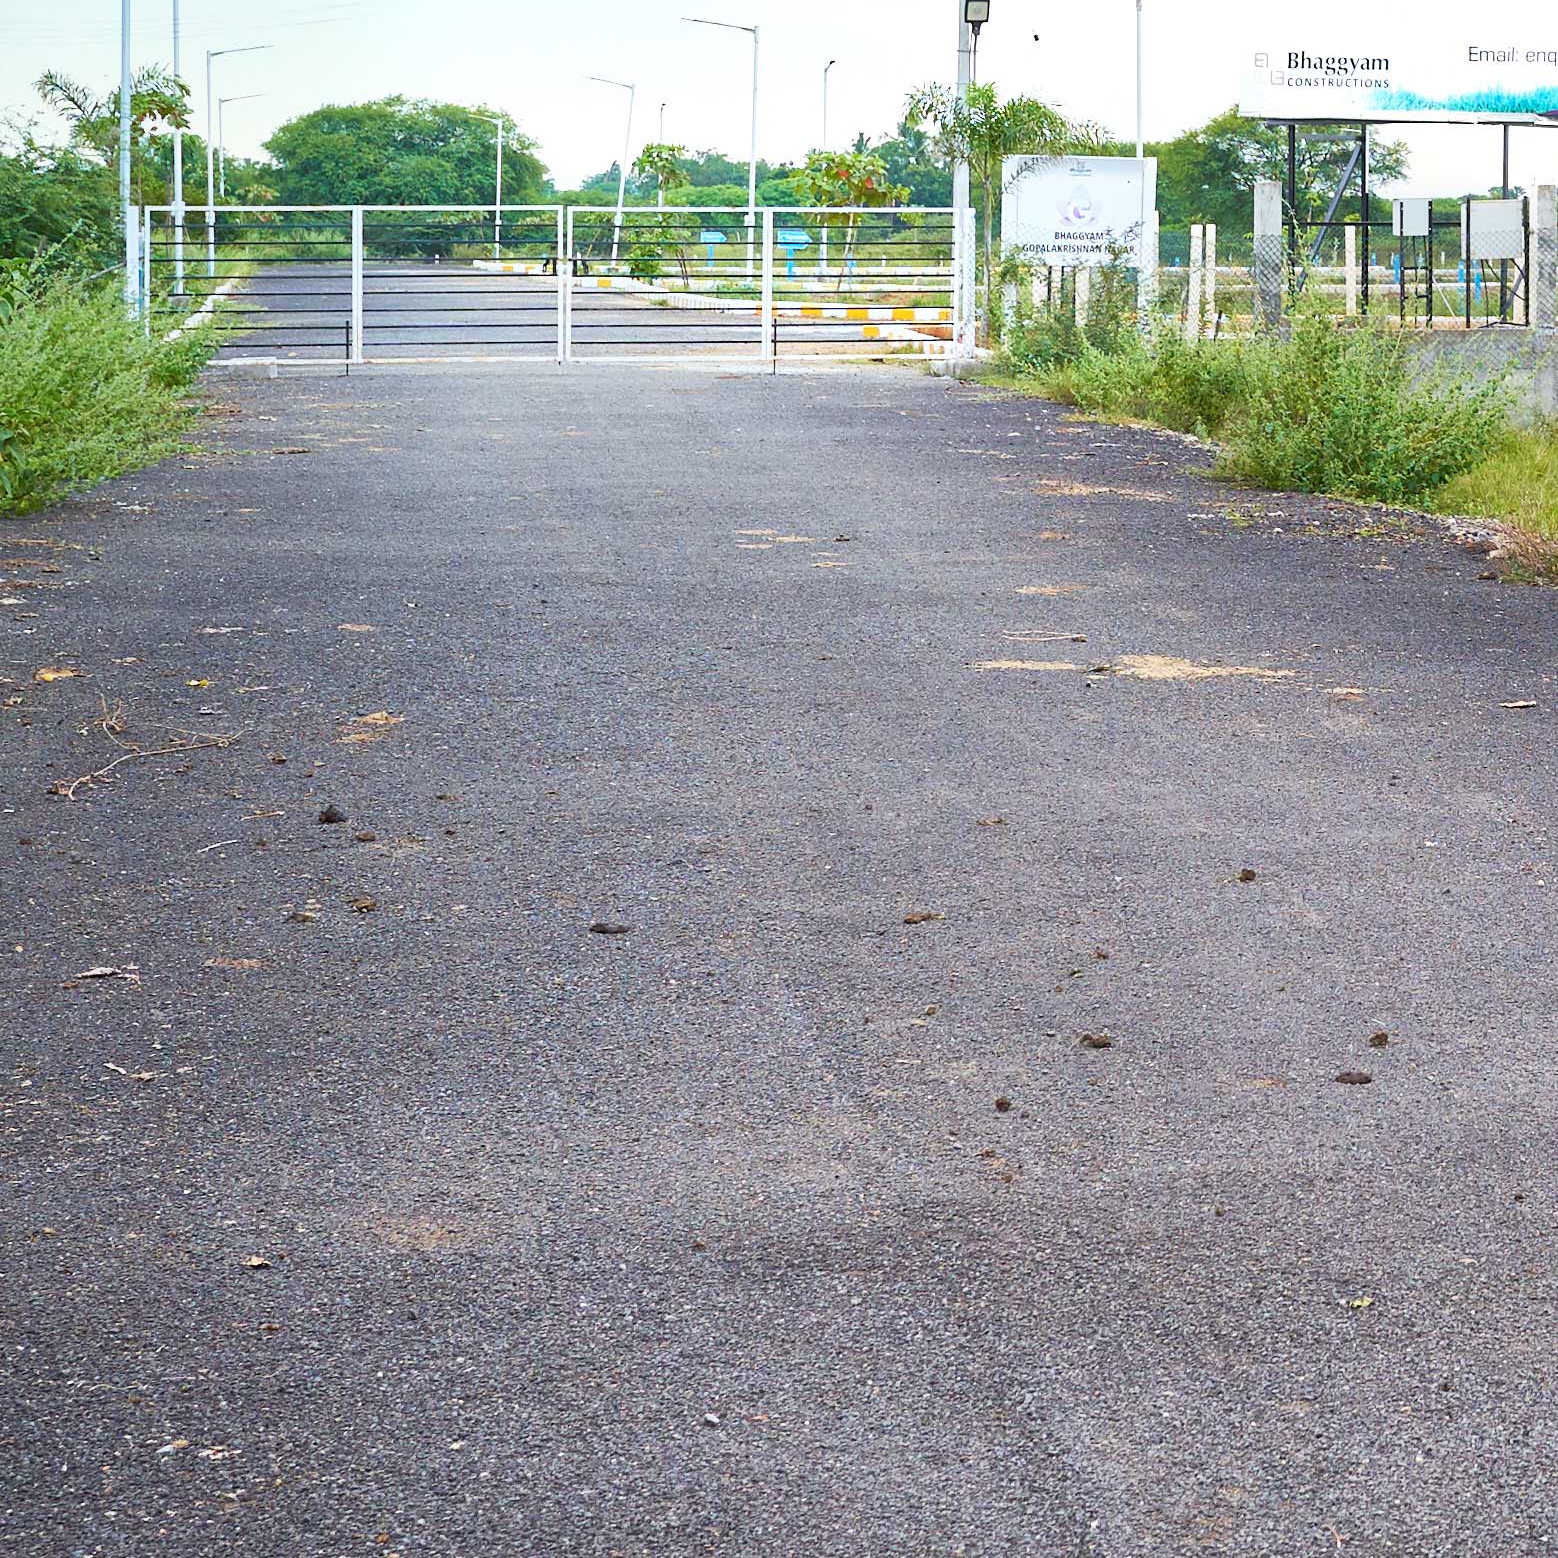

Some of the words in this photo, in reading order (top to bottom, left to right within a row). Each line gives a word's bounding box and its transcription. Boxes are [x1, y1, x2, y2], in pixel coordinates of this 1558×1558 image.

[1468, 46, 1519, 62] Email:
[1287, 51, 1389, 76] Bhaggyam
[1287, 77, 1390, 89] CONSTRUCTIONS
[1054, 231, 1104, 241] BHAGGYAM
